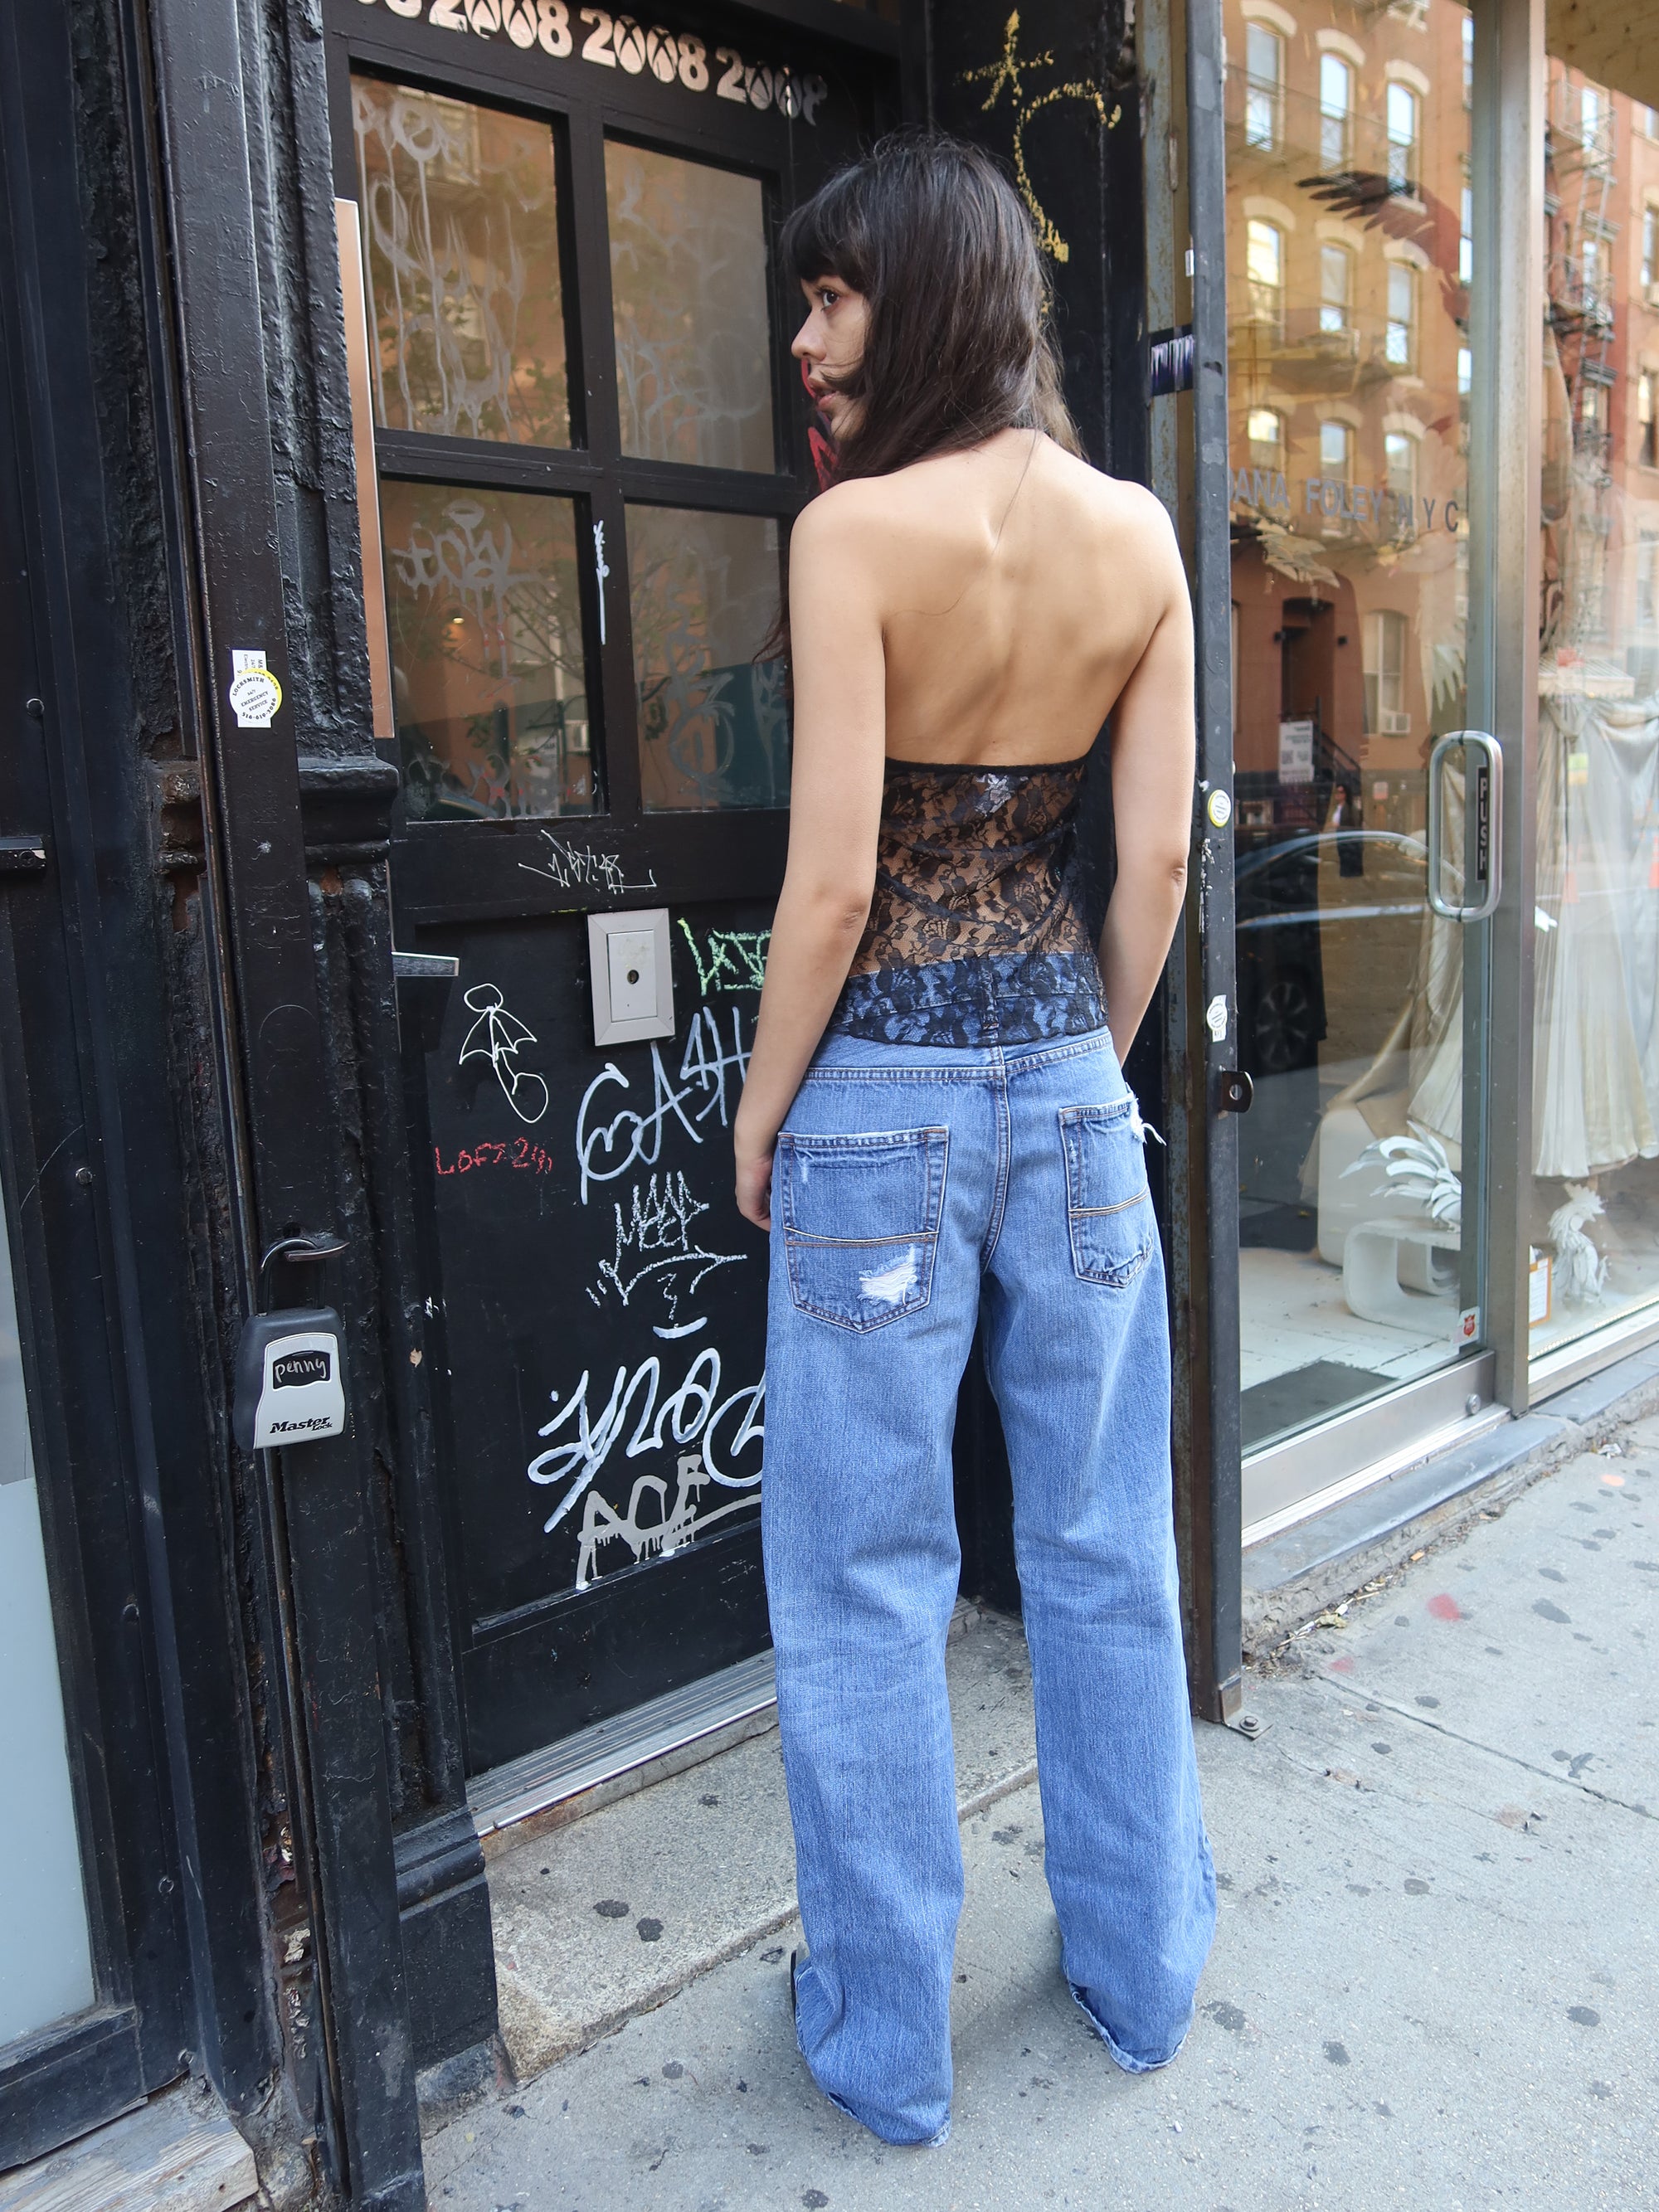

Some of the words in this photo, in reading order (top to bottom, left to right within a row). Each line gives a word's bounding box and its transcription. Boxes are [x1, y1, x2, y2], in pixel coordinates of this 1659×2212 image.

[581, 7, 709, 91] 2008
[1305, 477, 1384, 524] FOLEY
[232, 677, 265, 696] LOCKSMITH
[241, 691, 268, 707] EMERGENCY
[249, 699, 268, 711] SERVICE
[269, 1416, 331, 1434] Master
[311, 1422, 333, 1432] Lock
